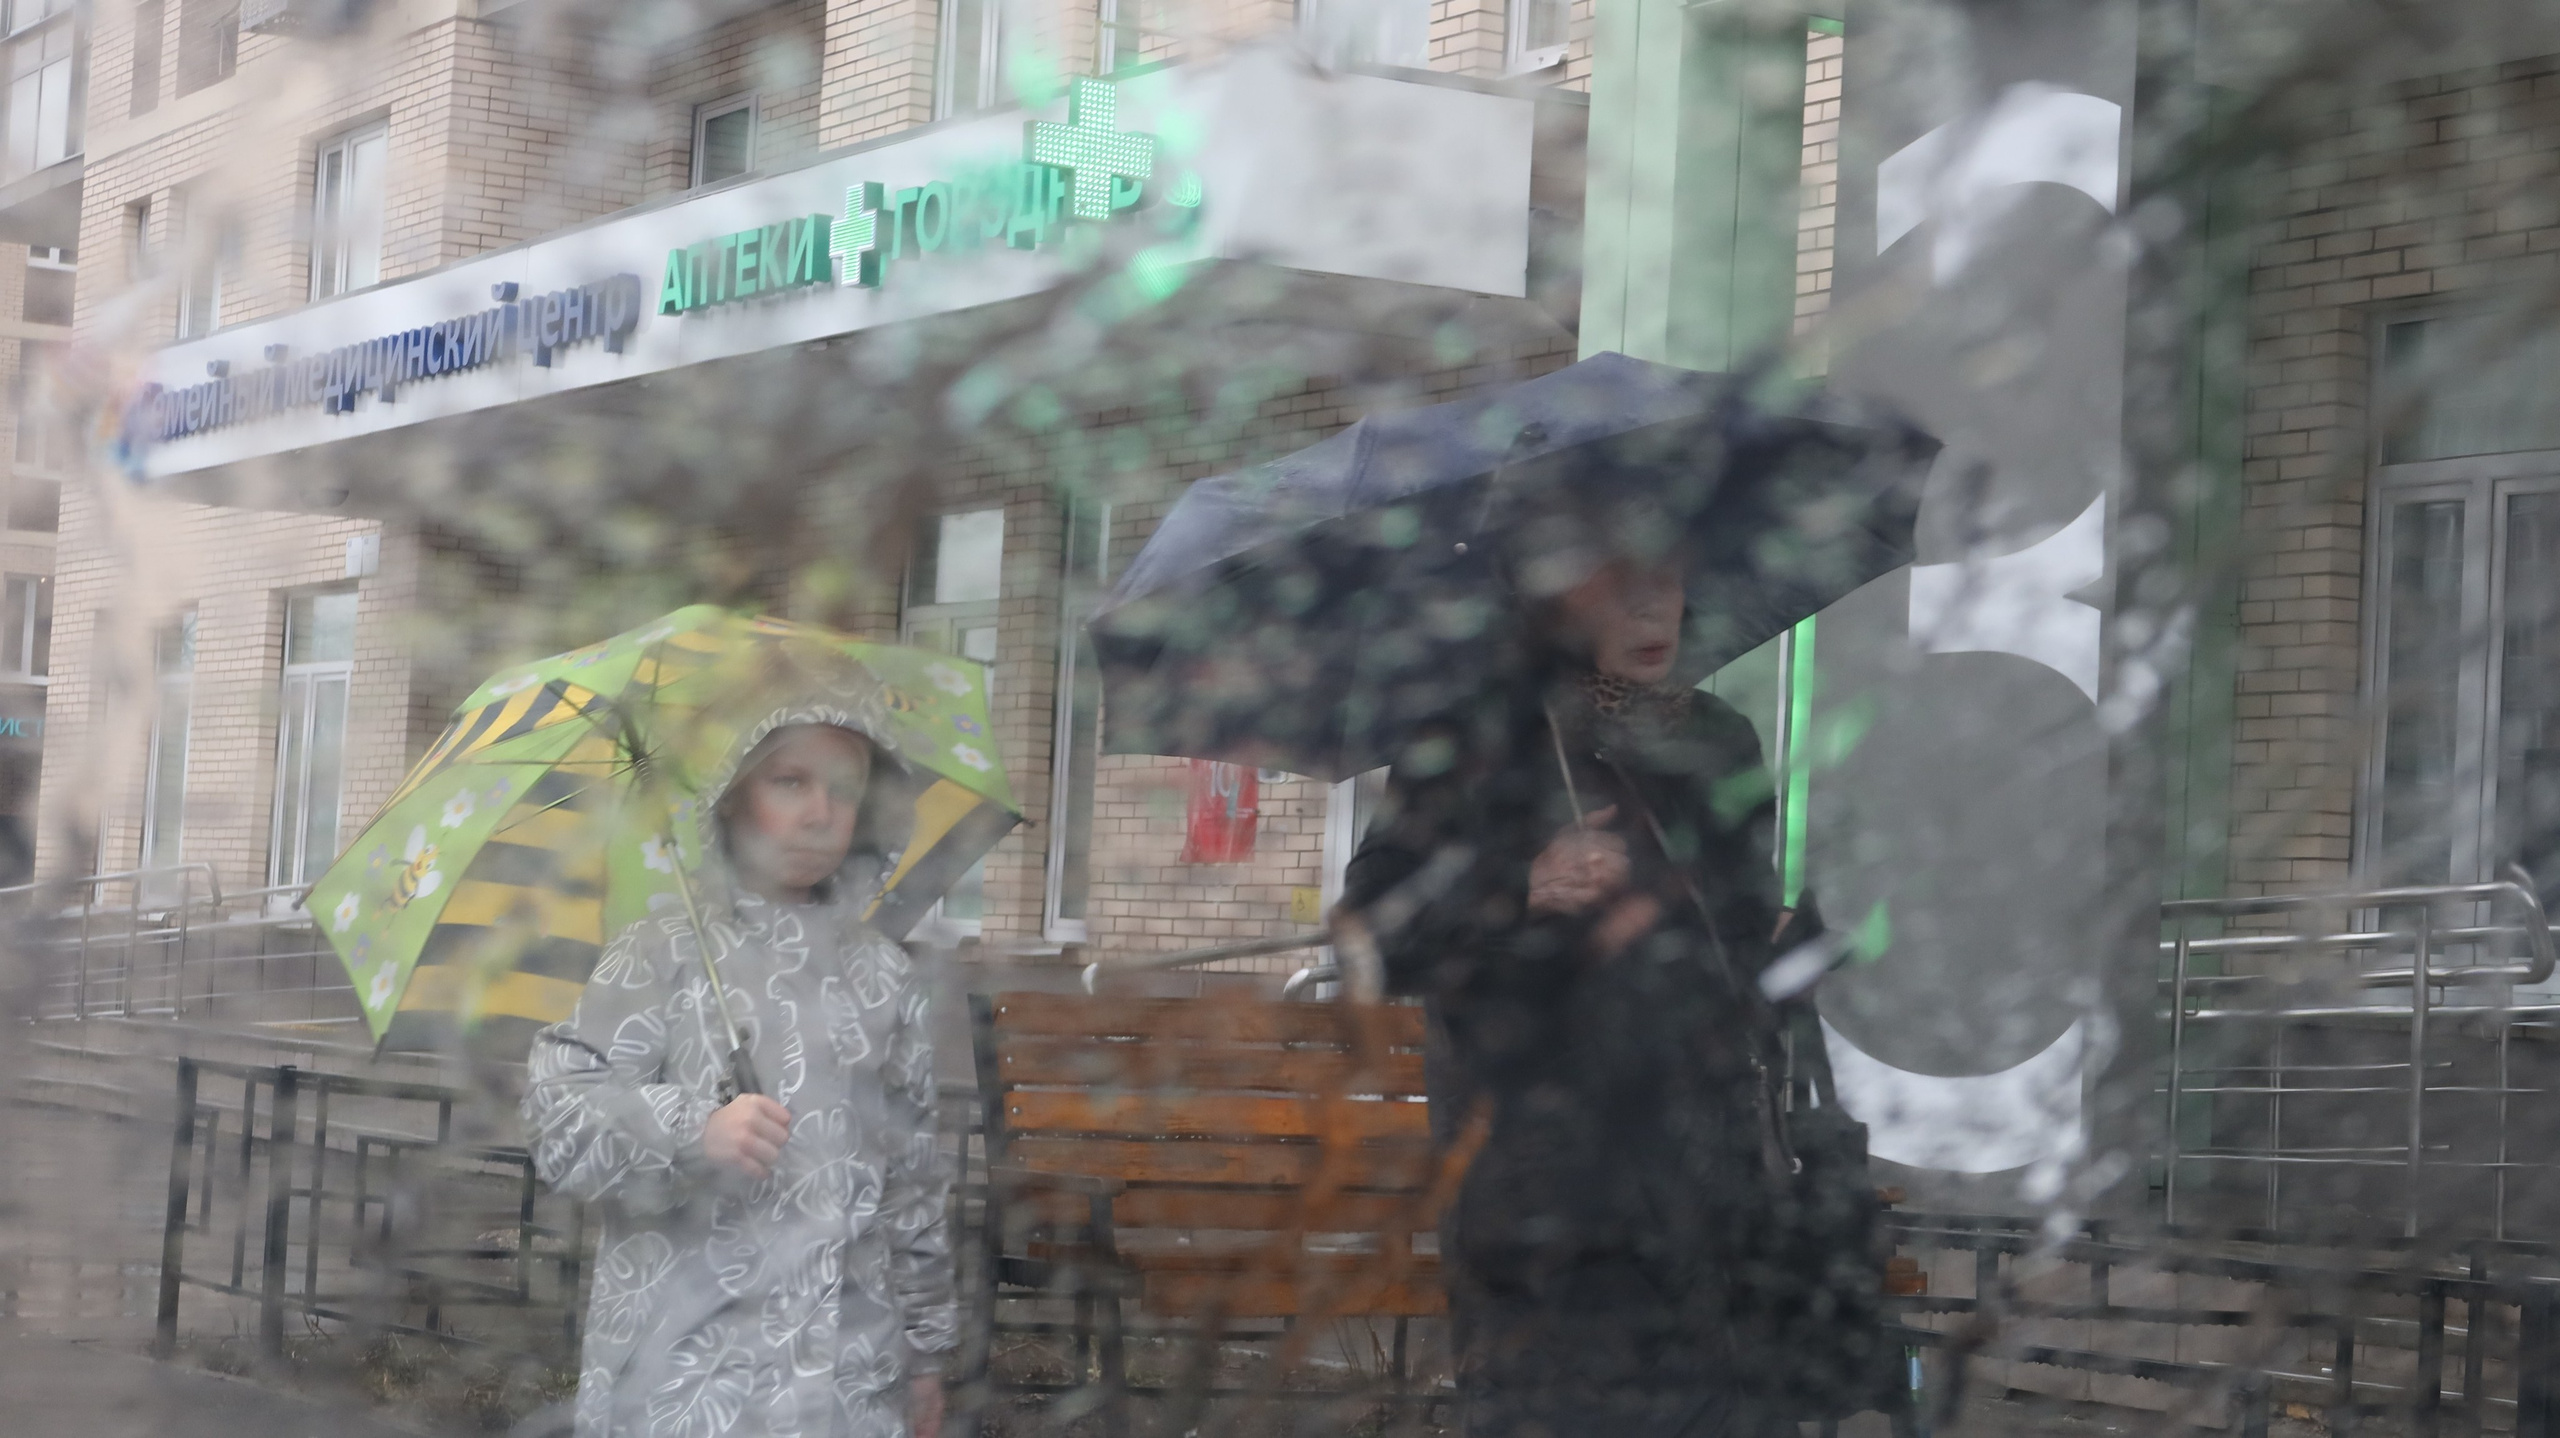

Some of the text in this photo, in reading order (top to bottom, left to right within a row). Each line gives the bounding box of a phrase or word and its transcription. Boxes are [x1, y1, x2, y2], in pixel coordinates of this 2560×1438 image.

[657, 213, 832, 315] АПТЕКИ
[284, 282, 518, 414] медицинский
[517, 273, 640, 366] центр
